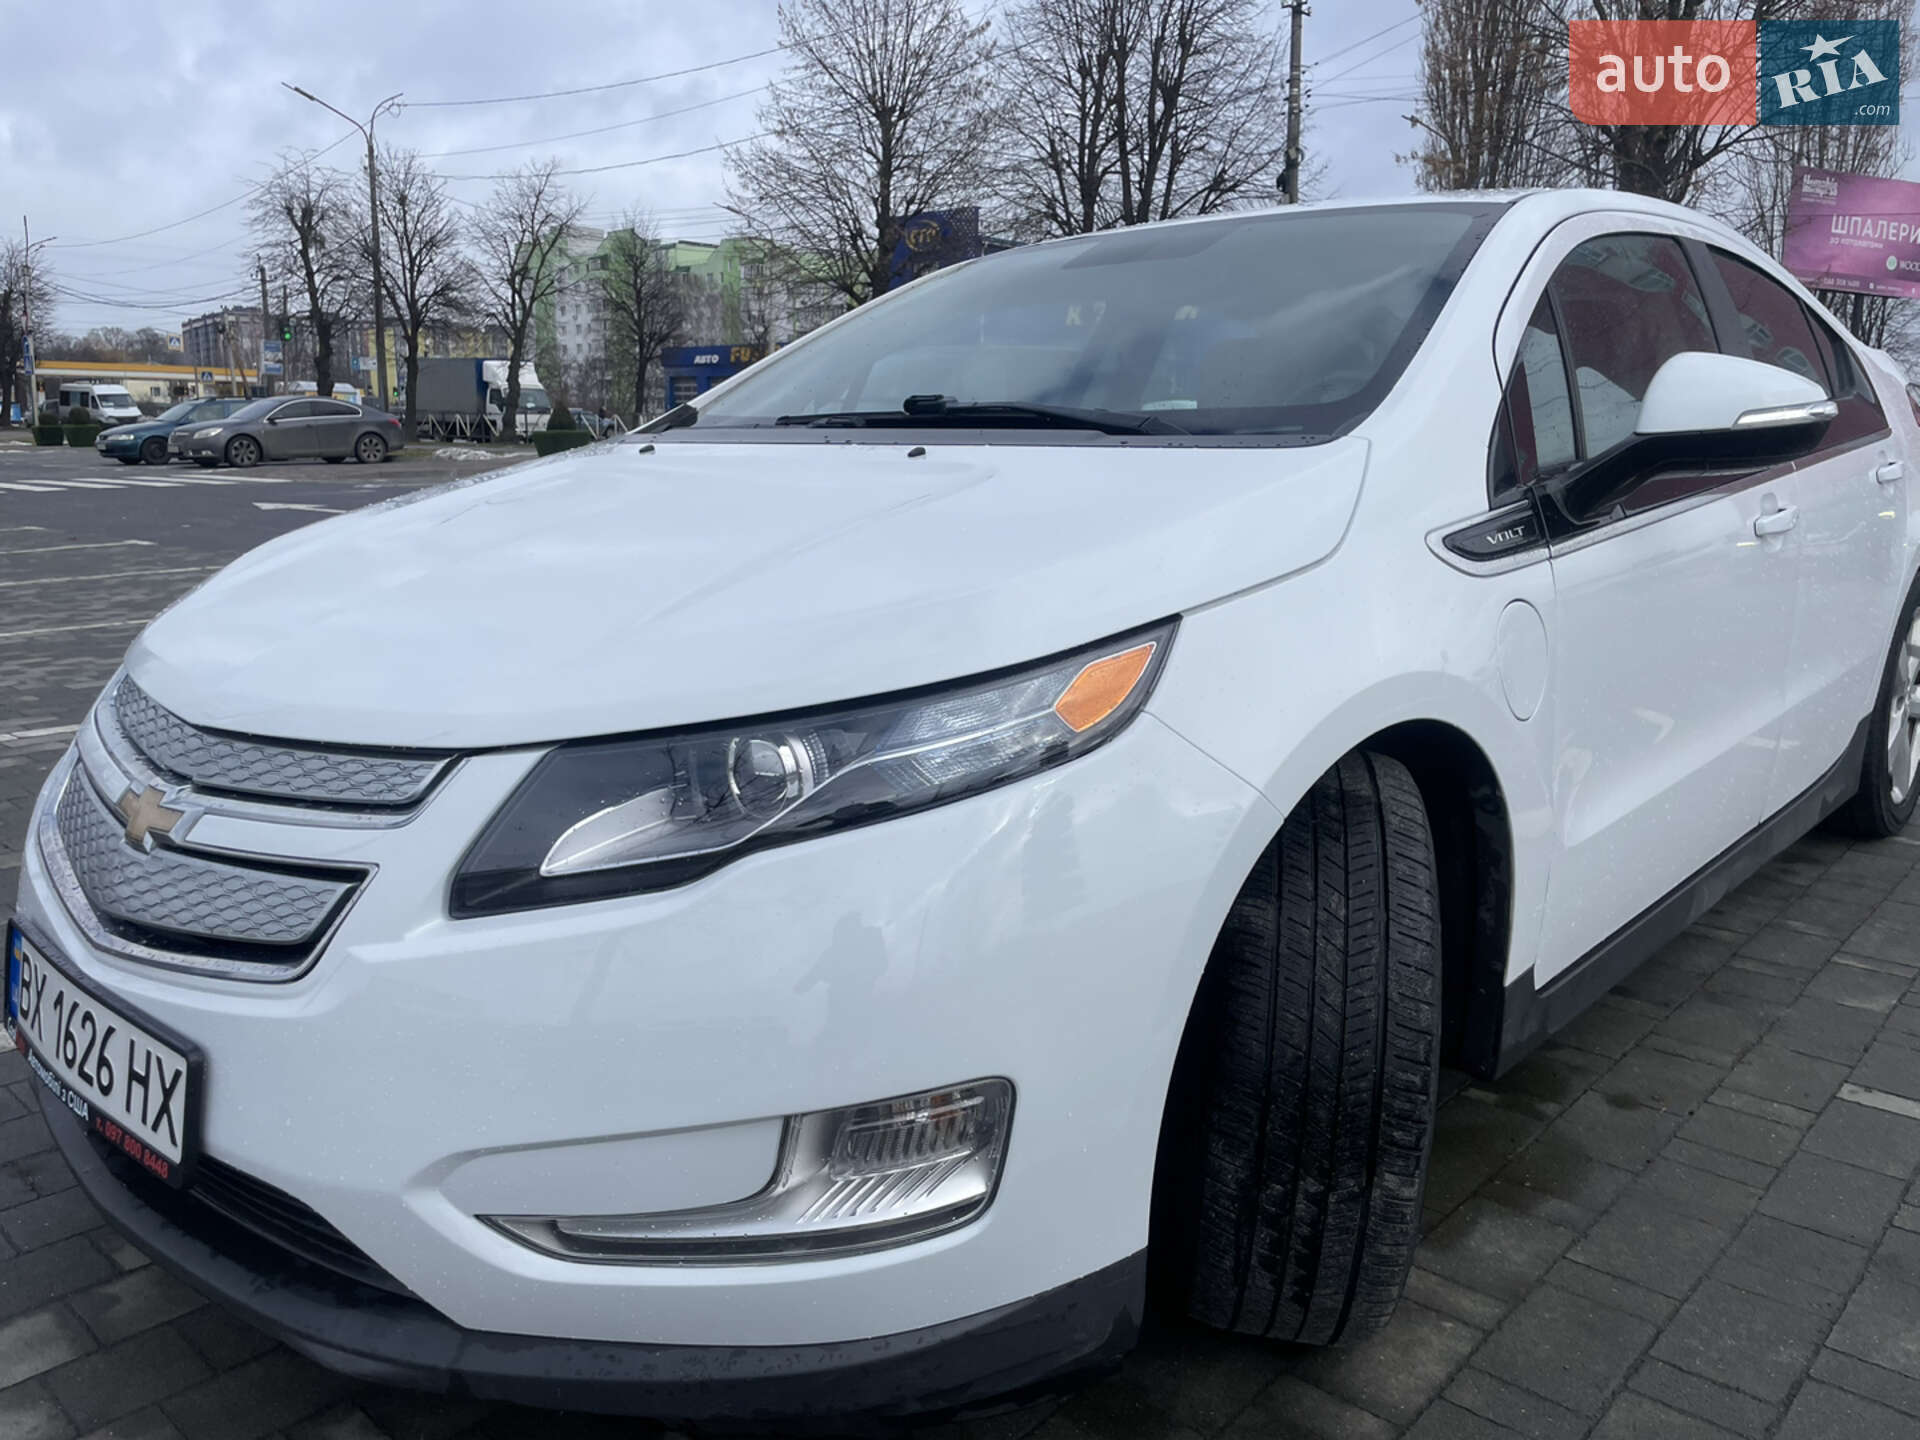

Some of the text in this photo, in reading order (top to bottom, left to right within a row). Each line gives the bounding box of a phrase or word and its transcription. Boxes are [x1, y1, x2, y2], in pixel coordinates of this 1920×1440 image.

[1486, 525, 1525, 545] VOLT
[20, 951, 184, 1148] BX 1626 HX
[67, 1090, 89, 1121] США
